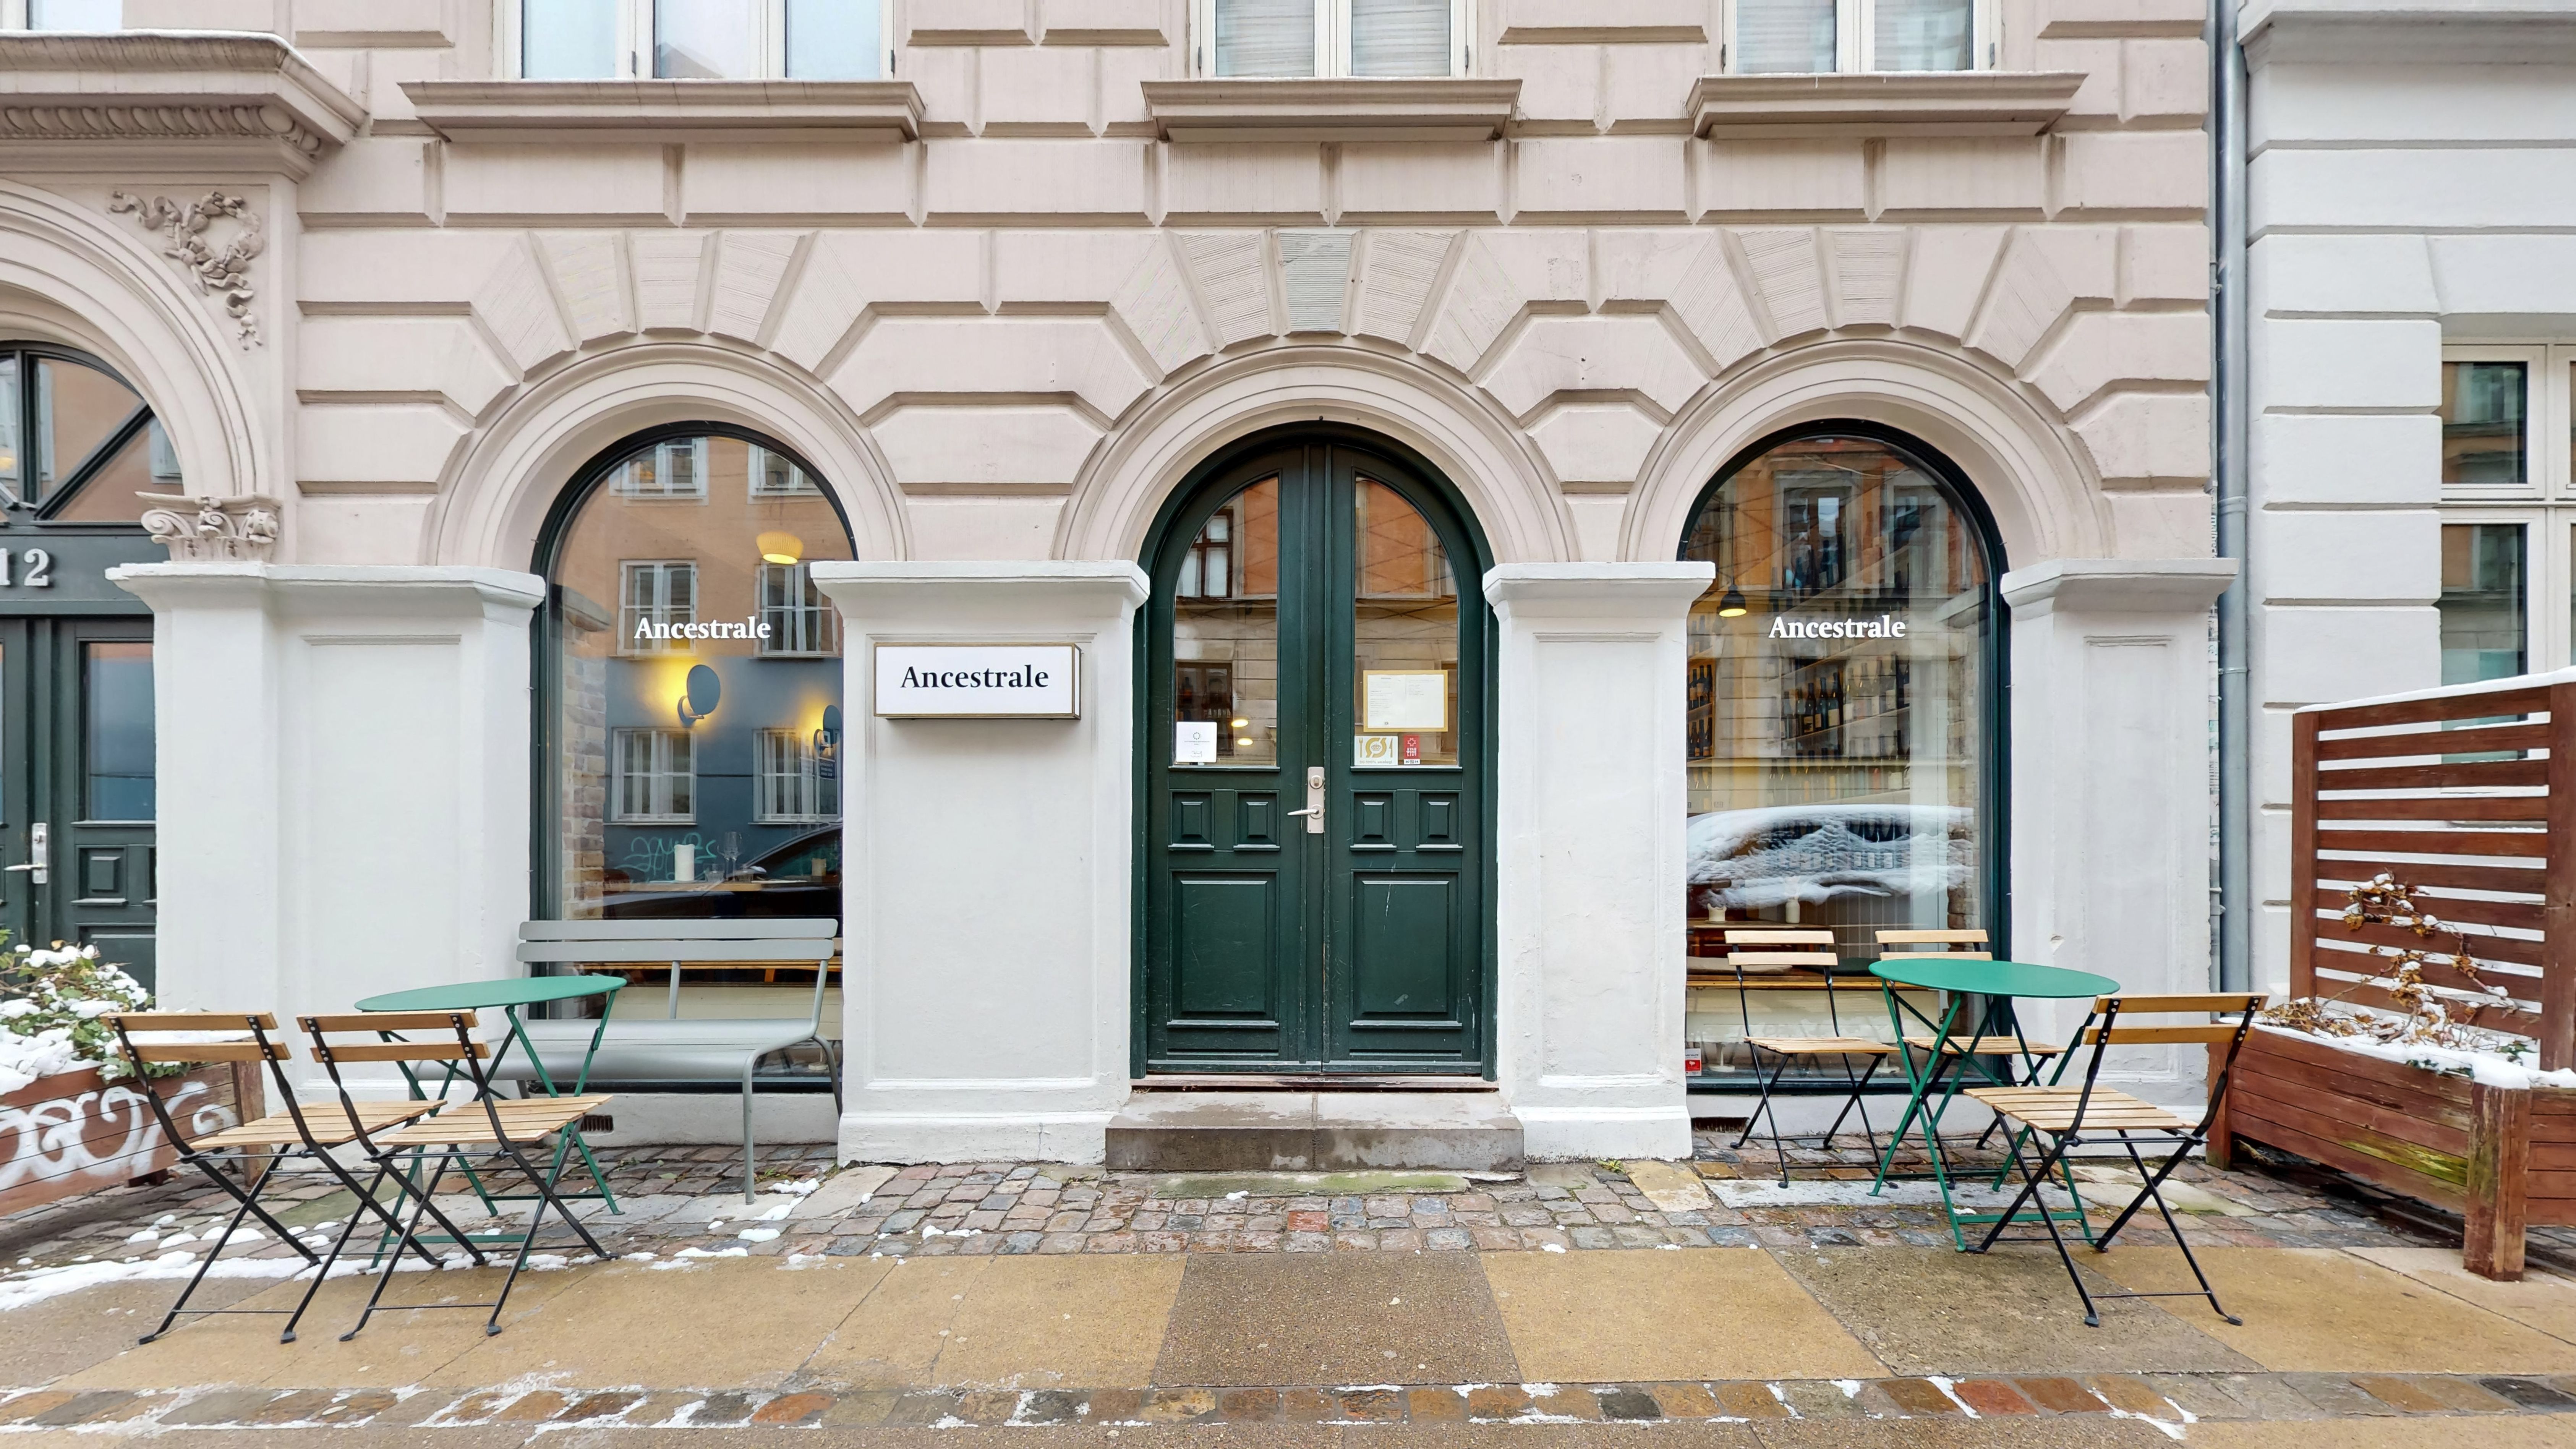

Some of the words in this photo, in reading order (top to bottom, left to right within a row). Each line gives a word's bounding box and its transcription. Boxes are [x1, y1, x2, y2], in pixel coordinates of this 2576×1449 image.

[0, 548, 49, 586] 12
[634, 616, 771, 639] Ancestrale
[1768, 614, 1905, 638] Ancestrale
[901, 664, 1049, 688] Ancestrale
